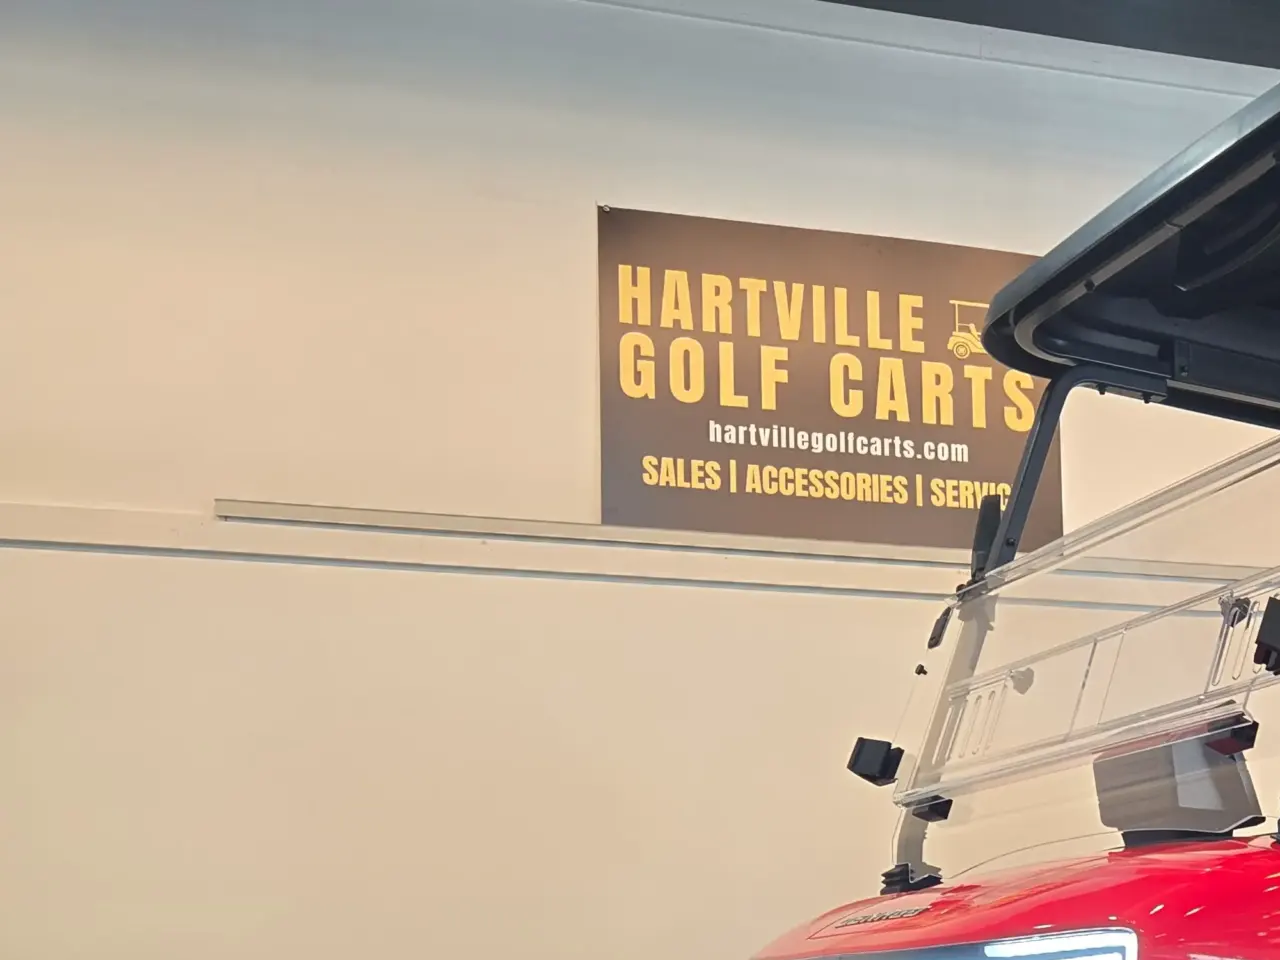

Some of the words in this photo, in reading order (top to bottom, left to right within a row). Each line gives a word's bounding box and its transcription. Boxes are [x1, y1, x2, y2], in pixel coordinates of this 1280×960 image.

[618, 264, 925, 353] HARTVILLE
[618, 332, 788, 411] GOLF
[829, 353, 1035, 432] CARTS
[709, 420, 969, 462] hartvillegolfcarts.com
[642, 455, 721, 491] SALES
[746, 464, 908, 506] ACCESSORIES
[931, 478, 1013, 511] SERVC
